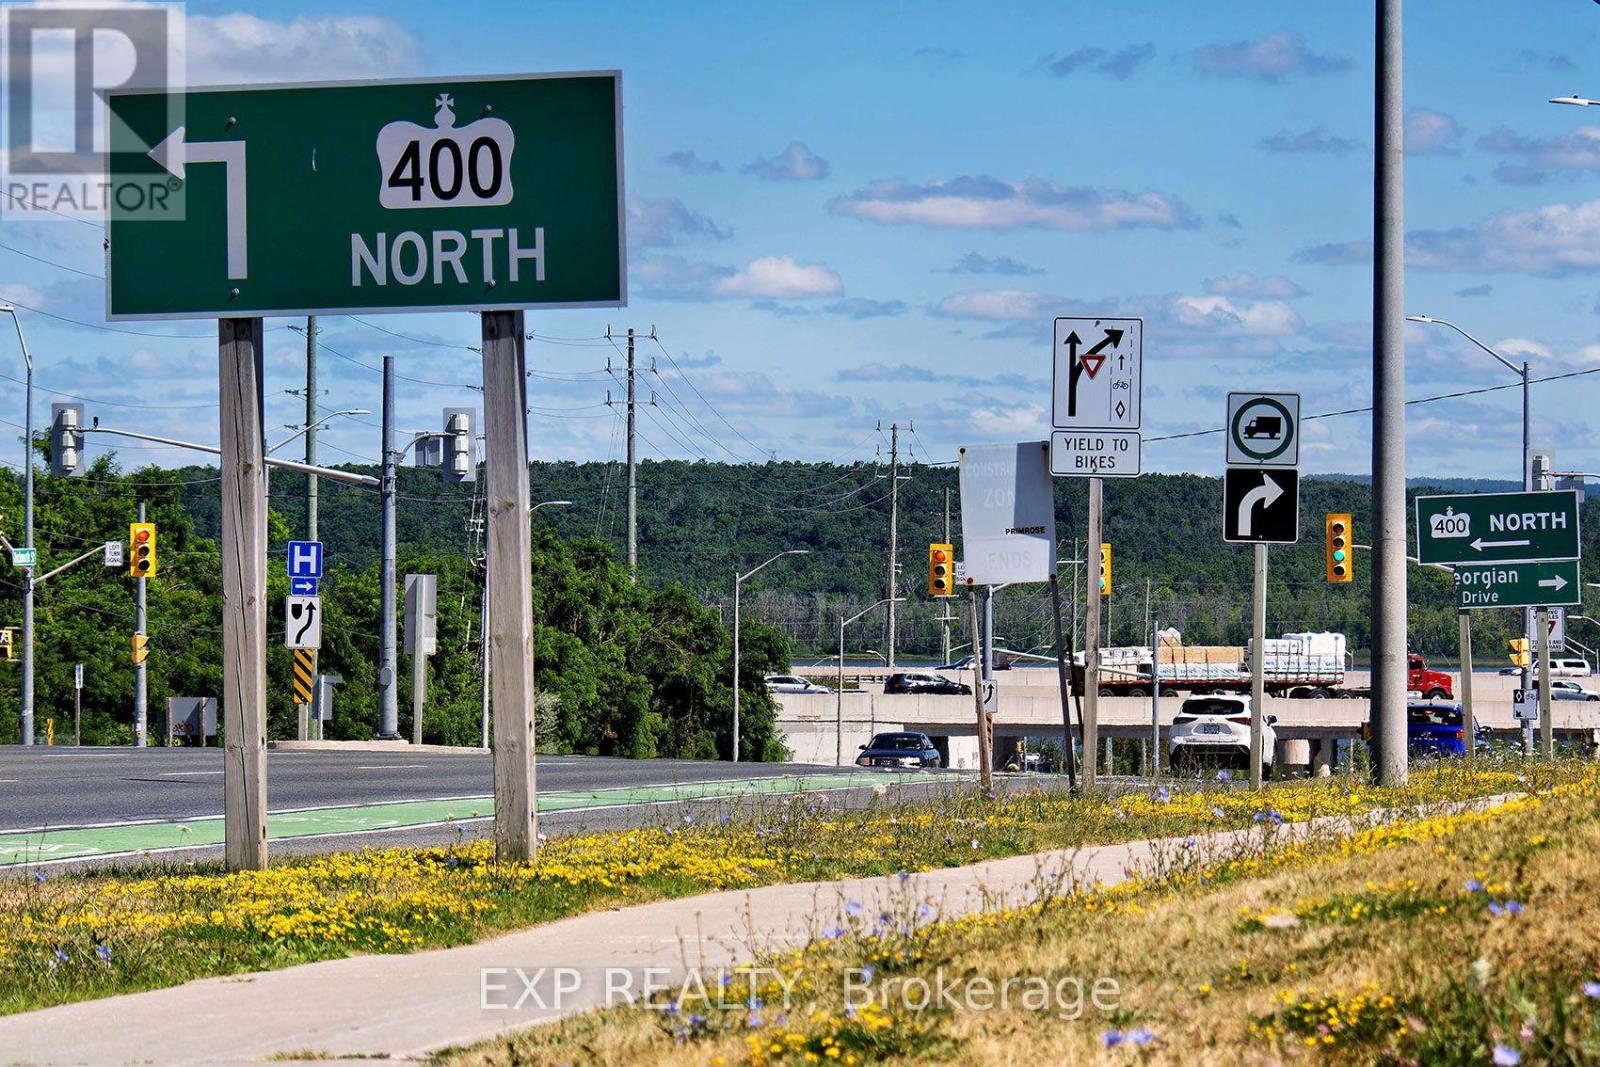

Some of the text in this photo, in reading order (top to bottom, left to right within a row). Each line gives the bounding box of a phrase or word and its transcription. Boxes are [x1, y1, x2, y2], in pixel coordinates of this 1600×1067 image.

[388, 136, 503, 202] 400
[351, 227, 546, 287] NORTH
[1064, 438, 1129, 451] YIELD TO
[1075, 456, 1116, 469] BIKES
[1005, 525, 1046, 535] PRIMROSE
[1434, 512, 1567, 534] 400 NORTH
[294, 545, 317, 574] H
[1453, 568, 1519, 589] eorgian
[1462, 590, 1499, 604] Drive
